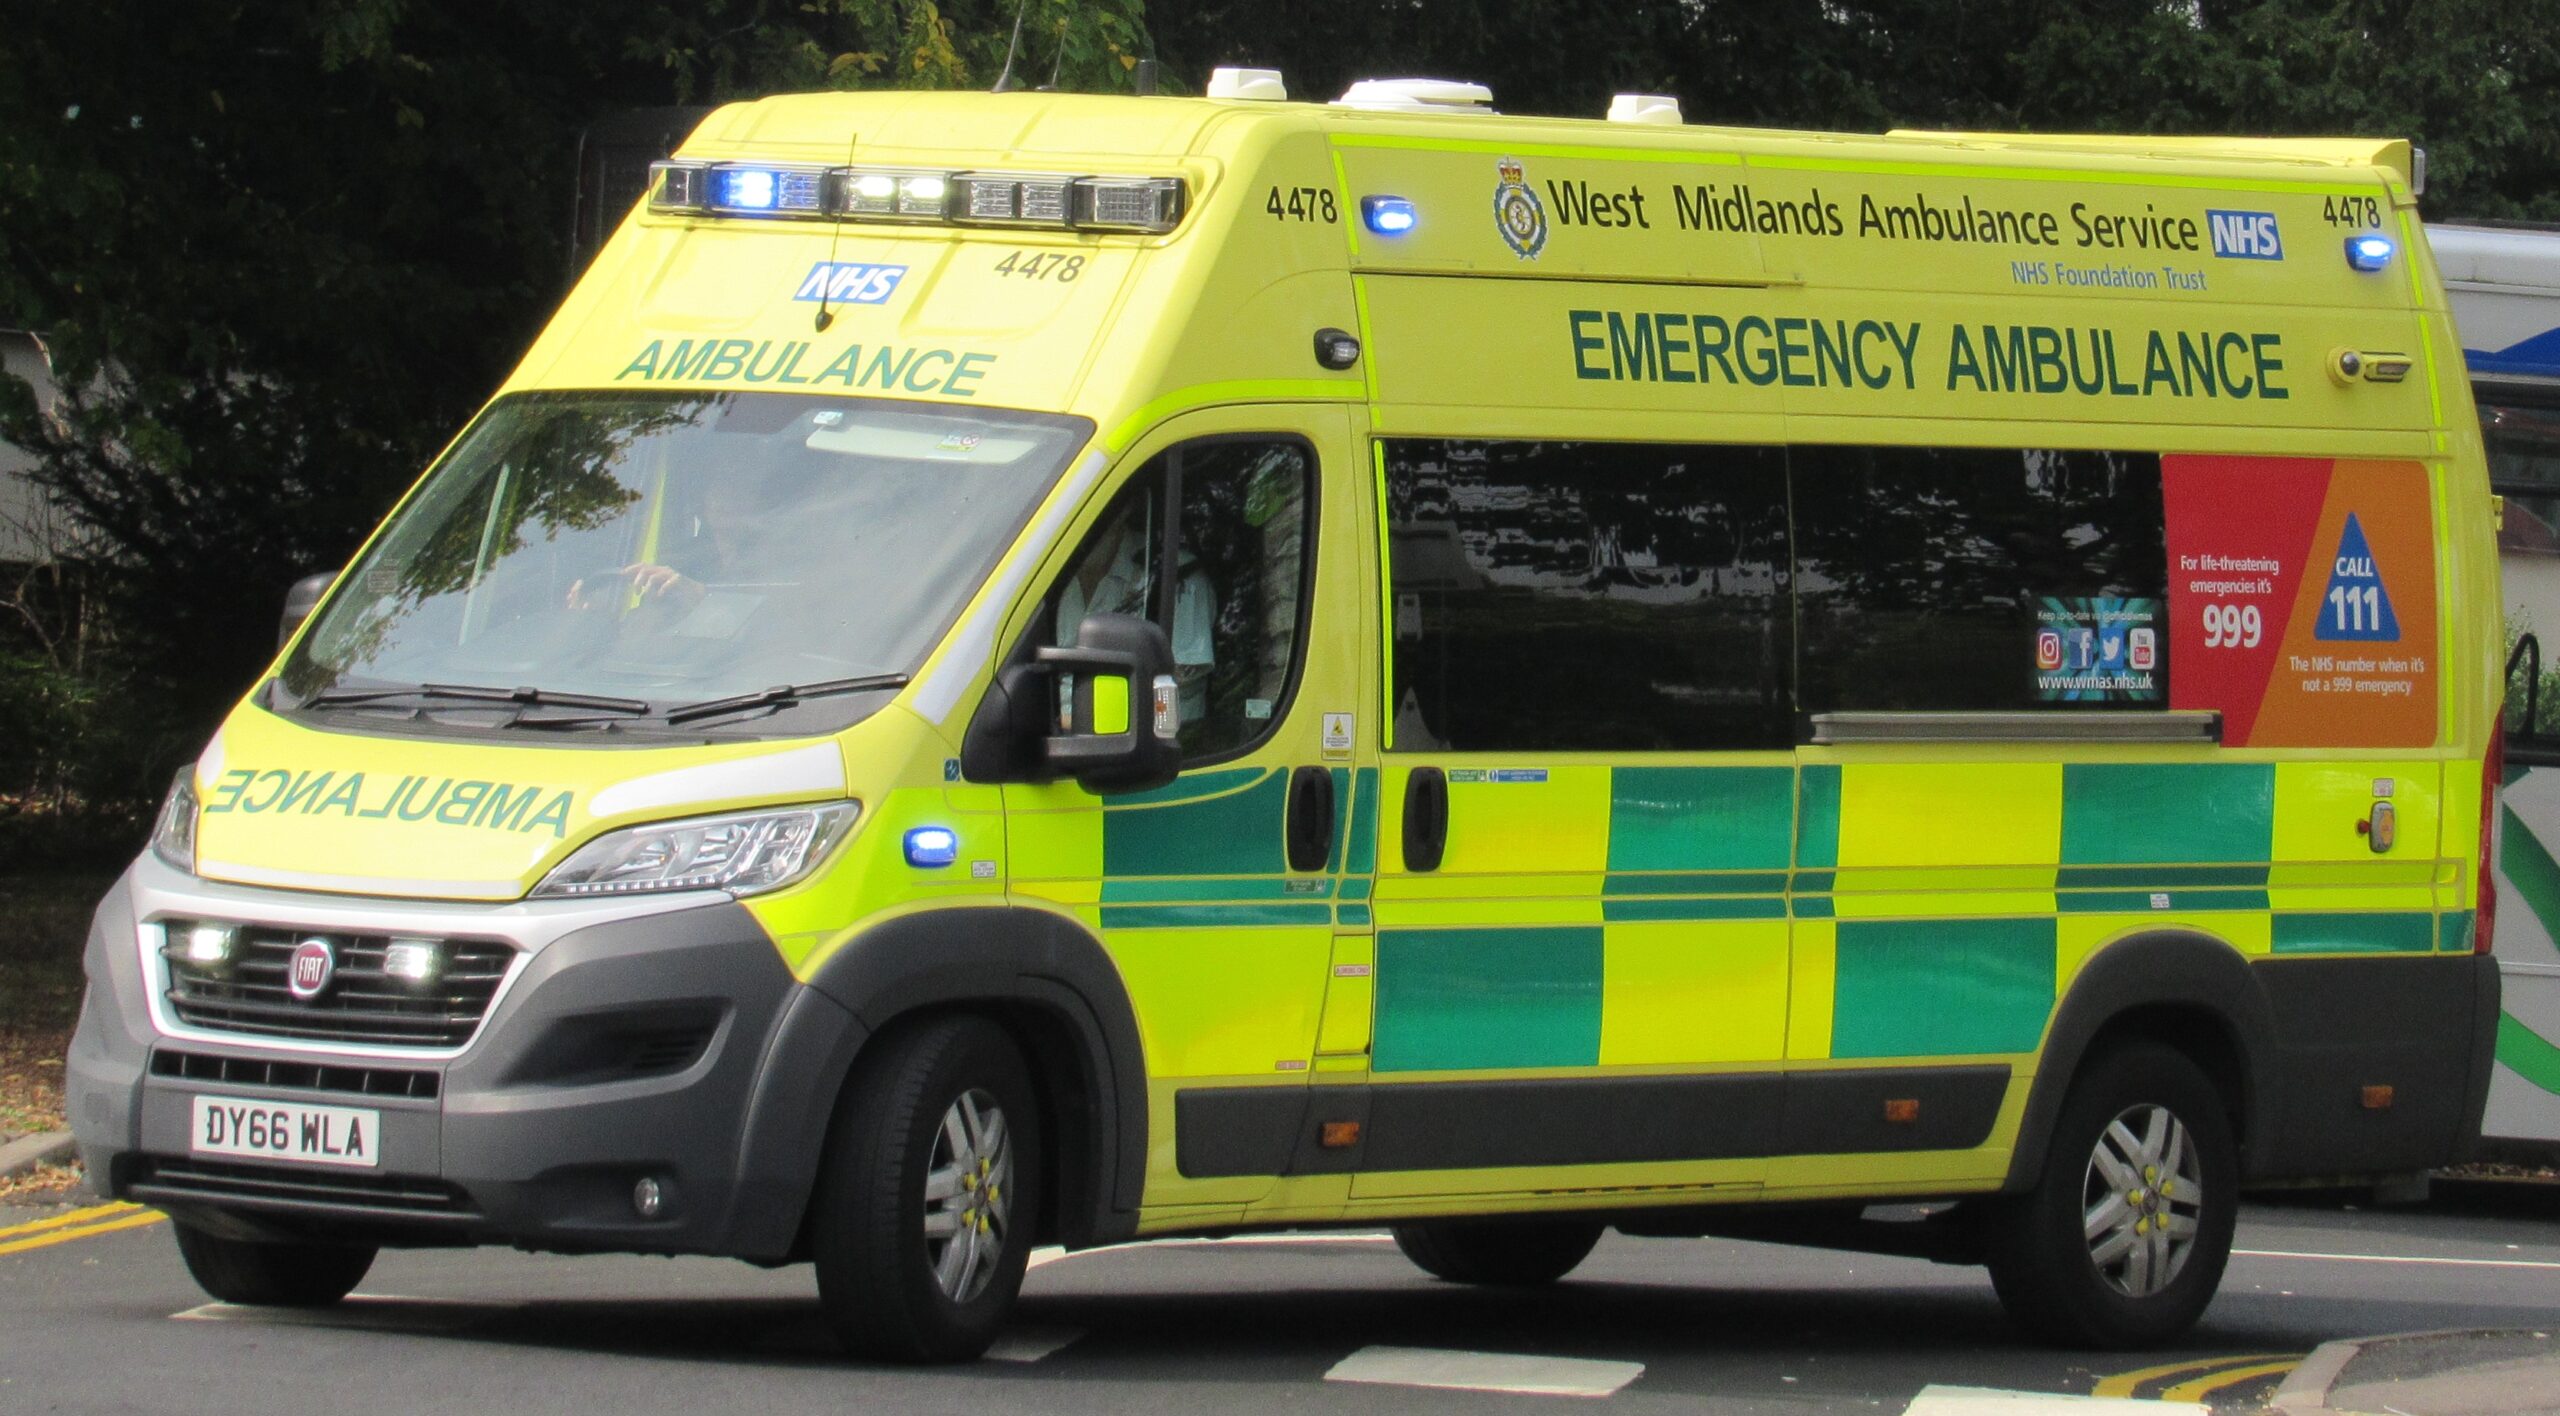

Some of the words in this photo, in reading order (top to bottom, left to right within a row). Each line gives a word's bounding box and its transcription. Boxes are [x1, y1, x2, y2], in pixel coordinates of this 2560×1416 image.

[1266, 186, 1338, 224] 4478
[1546, 179, 1650, 229] West
[1673, 184, 1843, 238] Midlands
[1859, 192, 2059, 246] Ambulance
[2071, 203, 2200, 252] Service
[2211, 213, 2279, 258] NHS
[2323, 195, 2382, 231] 4478
[799, 263, 903, 302] NHS
[995, 251, 1086, 283] 4478
[2011, 261, 2049, 286] NHS
[2055, 262, 2157, 291] Foundation
[2164, 266, 2207, 292] Trust
[615, 339, 998, 397] AMBULANCE
[1568, 309, 1922, 391] EMERGENCY
[1946, 323, 2290, 400] AMBULANCE
[2180, 555, 2198, 570] For
[2201, 554, 2279, 576] life-threatening
[2335, 556, 2374, 577] CALL
[2190, 578, 2255, 597] emergencies
[2329, 585, 2380, 631] 111
[2202, 604, 2262, 649] 999
[2038, 672, 2153, 689] www.wmas.nhs.uk
[2289, 656, 2309, 671] The
[2312, 656, 2333, 672] NHS
[2336, 656, 2376, 672] number
[2379, 657, 2407, 673] when
[2302, 677, 2320, 692] not
[2323, 681, 2330, 692] a
[2333, 677, 2352, 692] 999
[2355, 679, 2412, 696] emergency
[298, 954, 325, 985] FIAT
[206, 1105, 290, 1150] DY66
[300, 1113, 364, 1158] WLA
